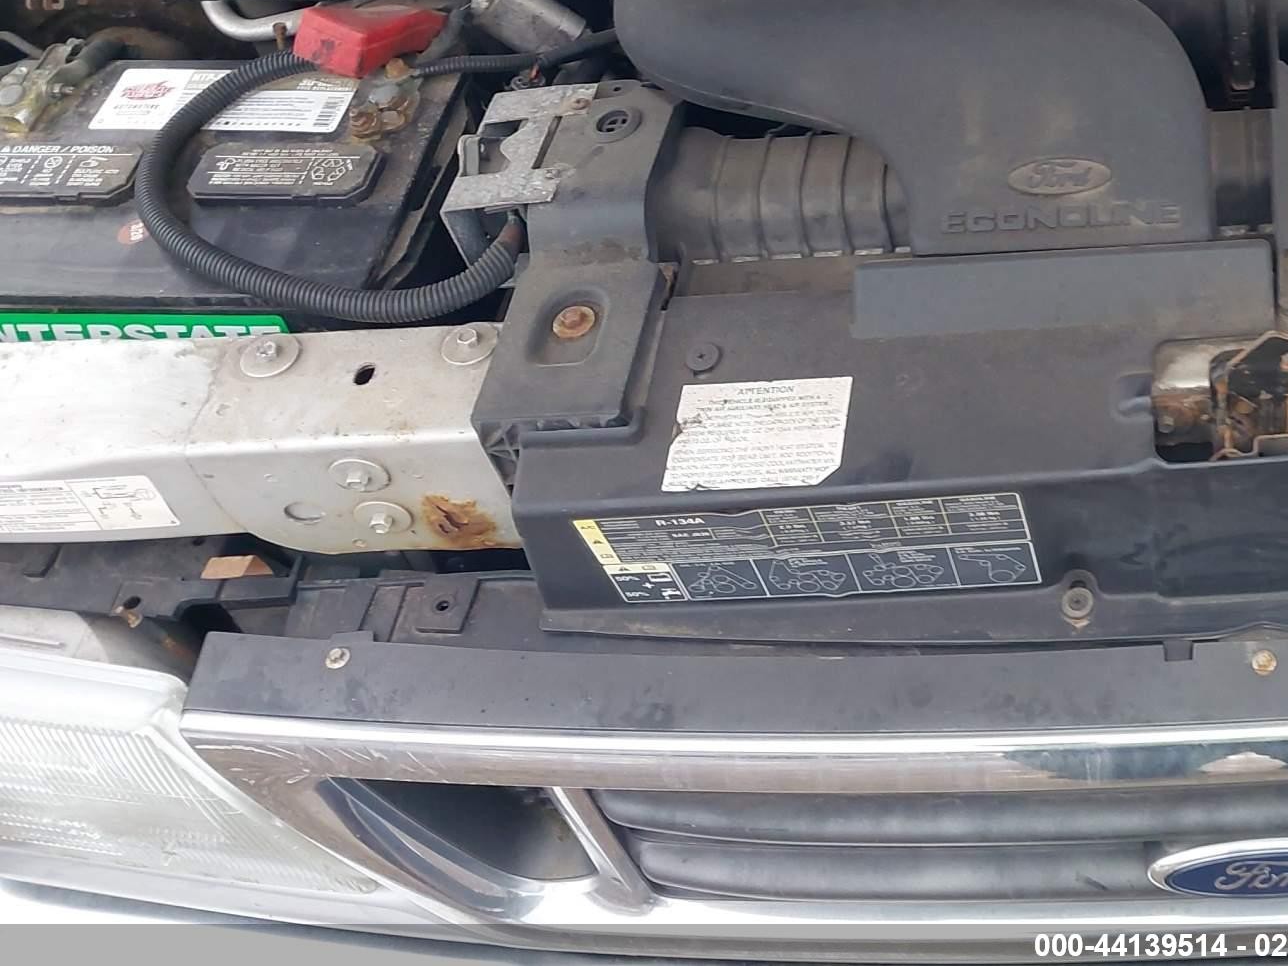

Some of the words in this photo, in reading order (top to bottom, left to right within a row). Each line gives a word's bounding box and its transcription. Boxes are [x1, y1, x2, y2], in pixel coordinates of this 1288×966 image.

[12, 145, 61, 153] DANGER
[70, 145, 114, 153] POISON
[941, 201, 1183, 235] ECONOLINE
[737, 385, 795, 395] ATTENTION
[655, 517, 706, 527] R-134A
